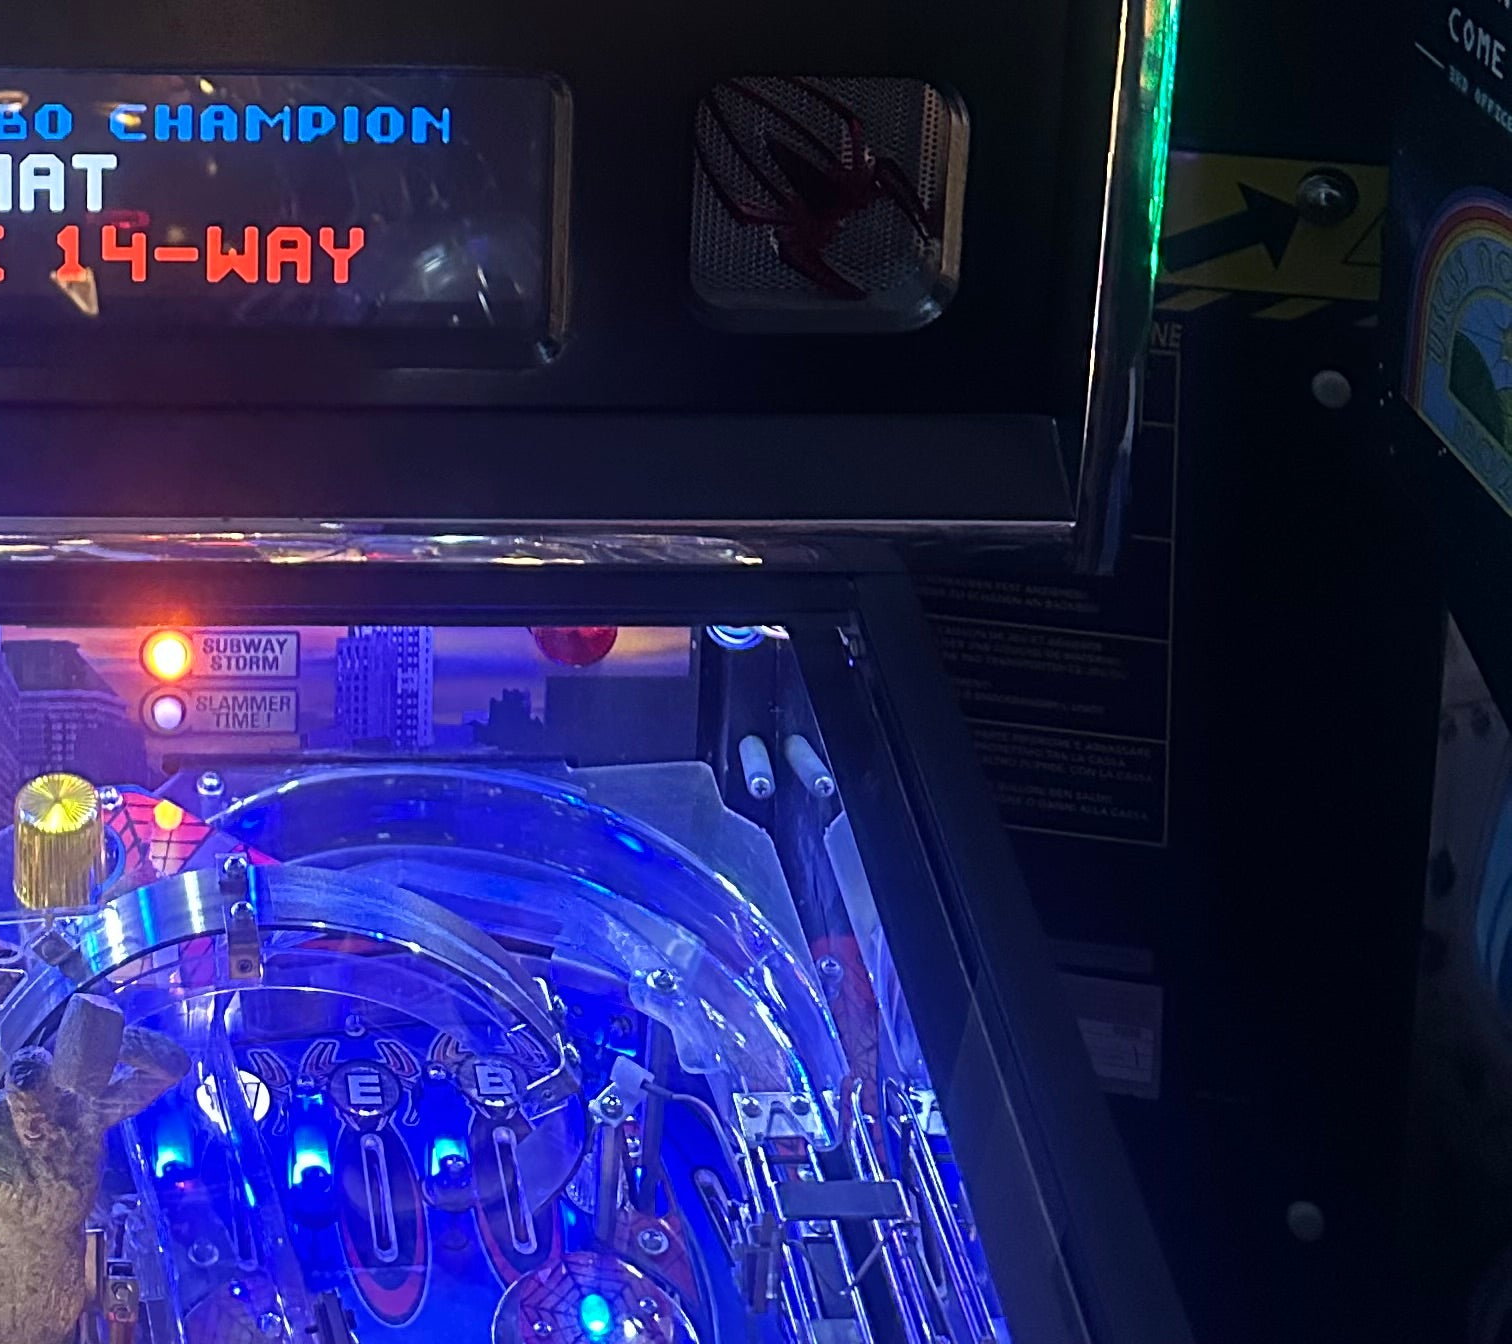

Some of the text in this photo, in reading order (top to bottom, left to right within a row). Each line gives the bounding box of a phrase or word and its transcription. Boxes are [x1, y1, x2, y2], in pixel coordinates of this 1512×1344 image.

[1447, 7, 1506, 80] COME
[108, 104, 450, 144] CHAMPION
[55, 226, 364, 284] 14-WAY
[202, 638, 288, 654] SUBWAY
[210, 655, 280, 671] STORM
[195, 696, 291, 712] SLAMMER
[346, 1073, 383, 1106] E
